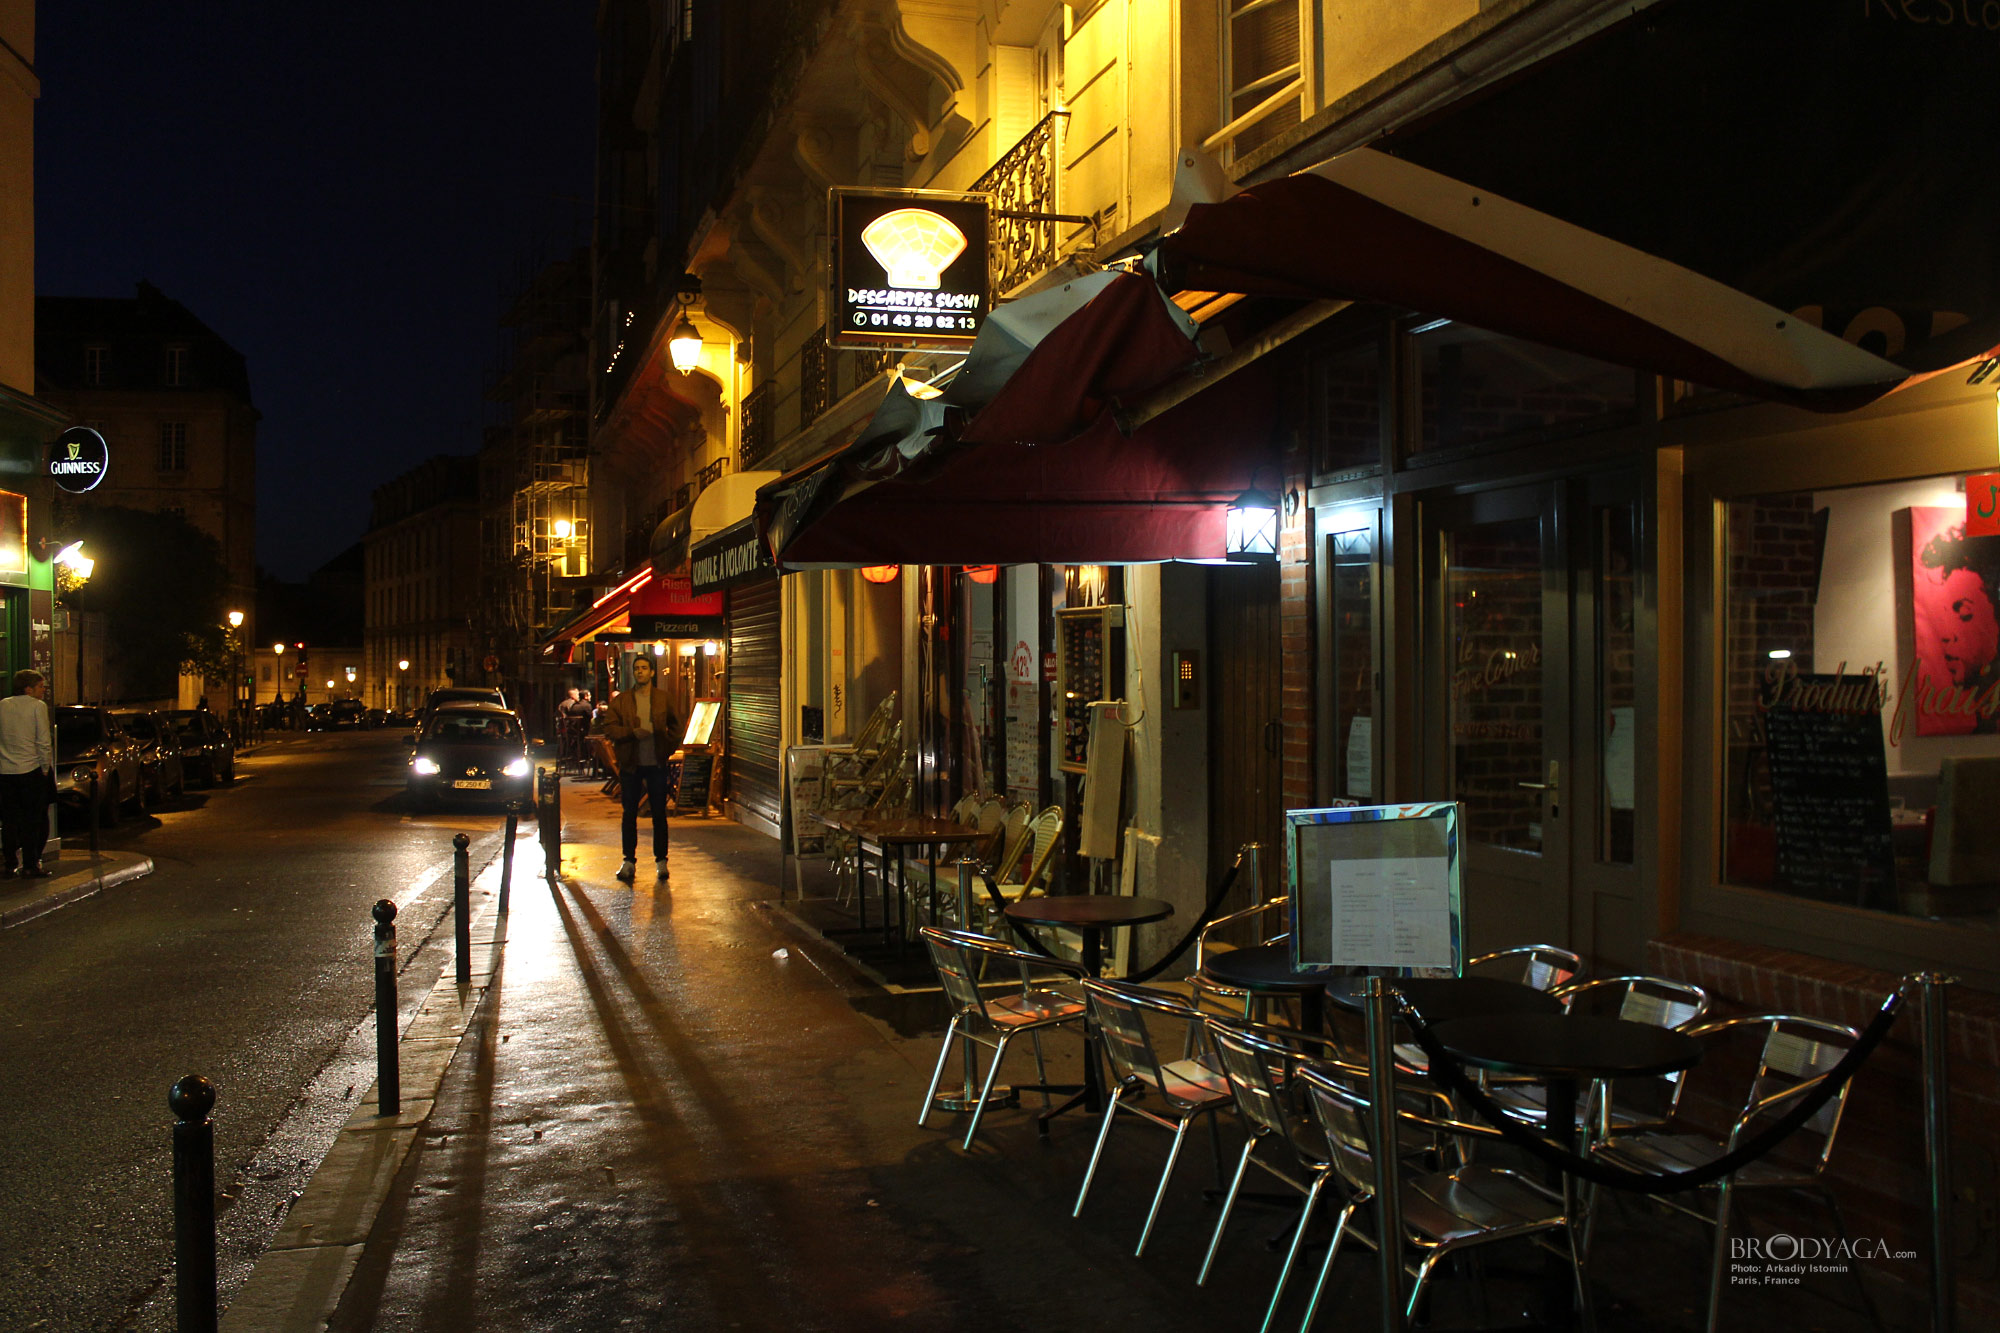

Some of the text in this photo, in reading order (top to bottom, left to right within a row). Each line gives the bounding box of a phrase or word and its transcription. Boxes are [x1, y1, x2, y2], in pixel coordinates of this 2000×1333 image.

[848, 289, 980, 309] DESCARTES SUSHI
[871, 313, 889, 326] 01
[893, 314, 912, 327] 43
[958, 317, 976, 329] 13
[50, 461, 101, 475] GUINNESS
[655, 622, 699, 633] Pizzeria
[1757, 659, 1891, 713] Produits
